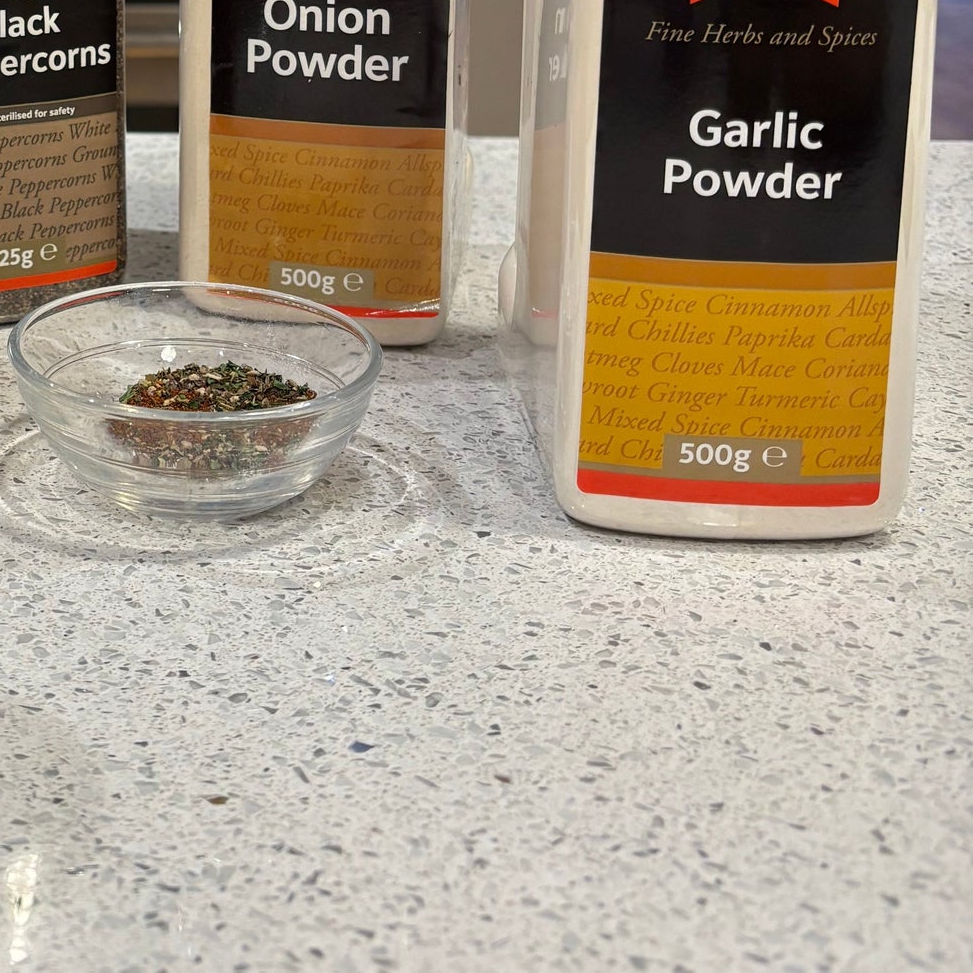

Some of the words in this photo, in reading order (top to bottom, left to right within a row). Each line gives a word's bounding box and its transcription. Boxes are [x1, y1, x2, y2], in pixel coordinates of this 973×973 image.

[644, 20, 694, 44] Fine
[701, 23, 763, 45] Herbs
[770, 25, 812, 46] and
[818, 25, 877, 52] Spices
[247, 38, 409, 82] Powder
[34, 109, 47, 117] for
[50, 106, 75, 116] safety
[68, 121, 111, 140] White
[689, 109, 824, 149] Garlic
[246, 144, 287, 166] Spice
[295, 148, 392, 171] Cinnamon
[8, 170, 97, 198] Peppercorns
[239, 168, 303, 189] Chillies
[310, 174, 380, 196] Paprika
[663, 158, 842, 200] Powder
[0, 200, 44, 220] Black
[257, 195, 310, 216] Cloves
[316, 203, 365, 219] Mace
[30, 216, 114, 239] Peppercorns
[255, 218, 315, 243] Ginger
[321, 224, 402, 246] Turmeric
[215, 238, 268, 260] Mixed
[273, 245, 319, 263] Spice
[325, 250, 427, 271] Cinnamon
[280, 268, 335, 295] 500g
[635, 289, 697, 319] Spice
[705, 294, 831, 318] Cinnamon
[628, 319, 714, 346] Chillies
[722, 326, 815, 353] Paprika
[651, 352, 723, 376] Cloves
[730, 356, 795, 378] Mace
[647, 381, 728, 411] Ginger
[736, 386, 840, 409] Turmeric
[588, 405, 666, 432] Mixed
[671, 414, 731, 436] Spice
[740, 416, 861, 439] Cinnamon
[679, 443, 752, 473] 500g
